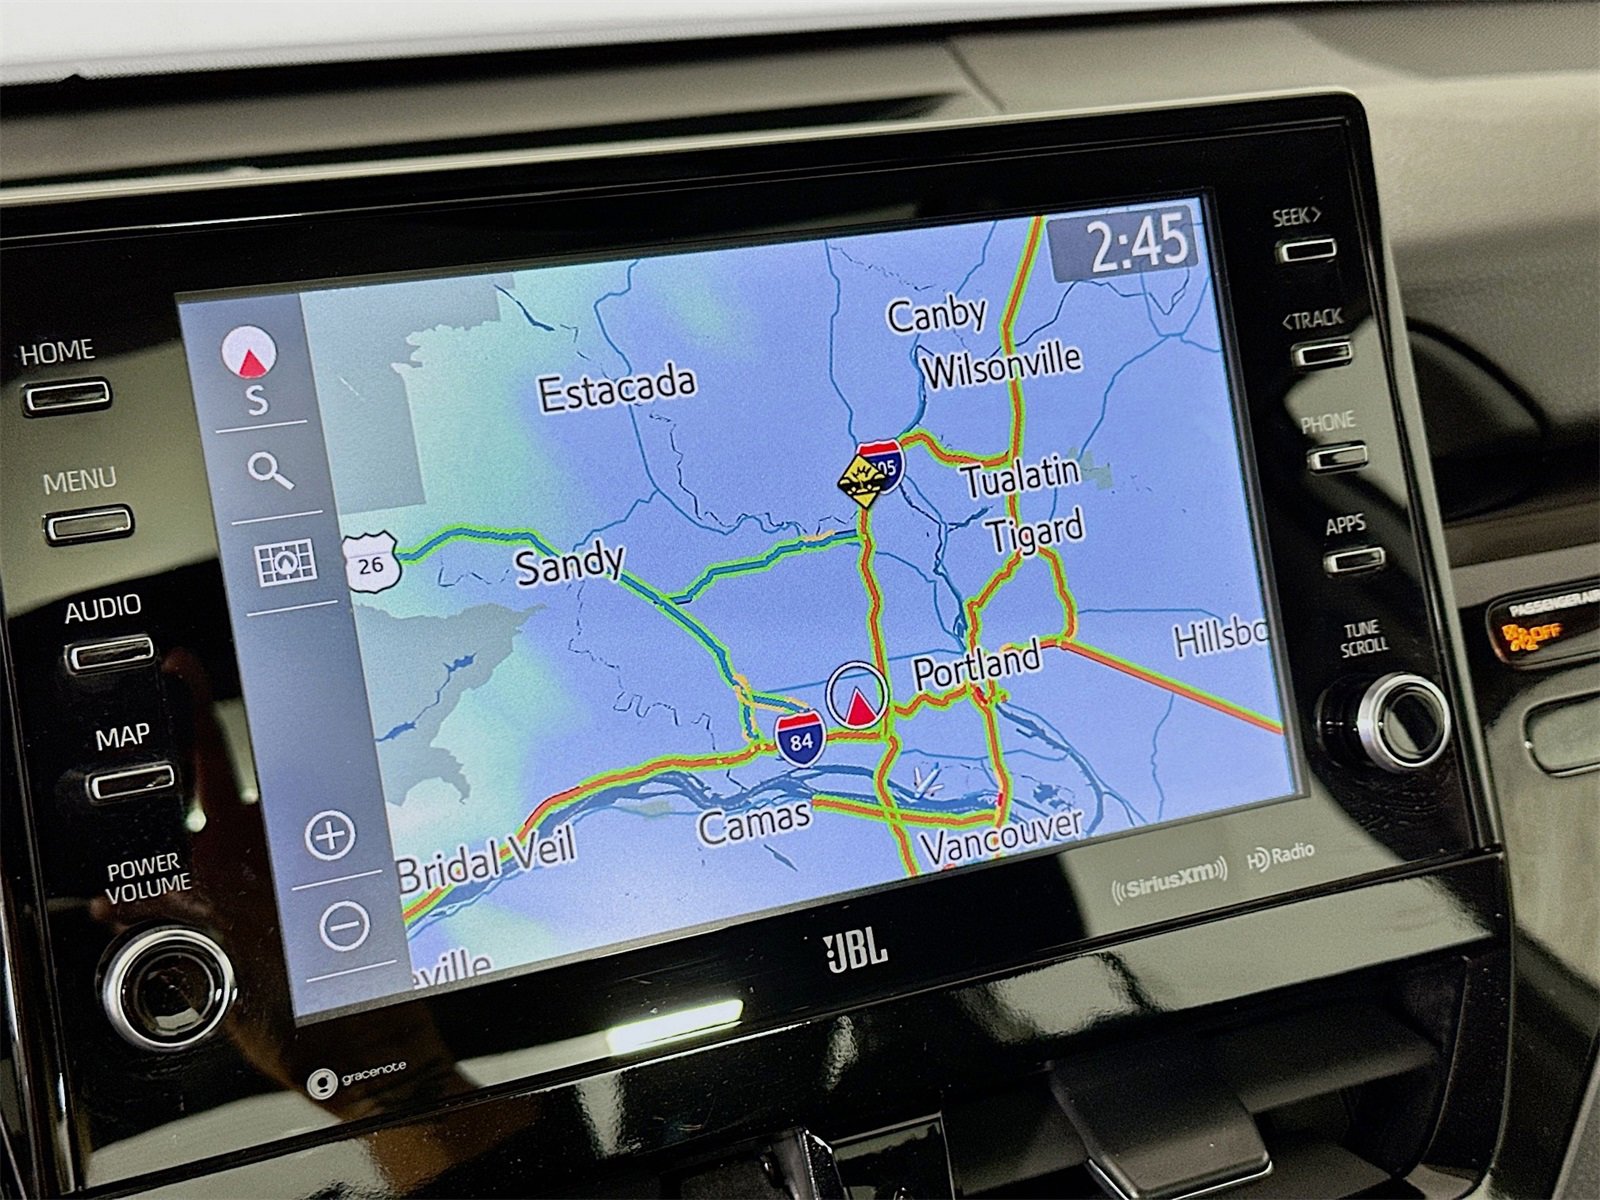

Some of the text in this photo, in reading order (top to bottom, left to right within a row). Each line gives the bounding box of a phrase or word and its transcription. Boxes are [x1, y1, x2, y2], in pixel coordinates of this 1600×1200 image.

[1086, 212, 1190, 274] 2:45
[887, 294, 986, 333] Canby
[20, 338, 96, 366] HOME
[921, 342, 1082, 390] Wilsonville
[245, 384, 270, 416] S
[537, 362, 697, 413] Estacada
[1301, 410, 1356, 434] PHONE
[43, 466, 117, 495] MENU
[959, 457, 1080, 499] Tualatin
[985, 507, 1083, 556] Tigard
[1325, 513, 1367, 536] APPS
[358, 556, 384, 576] 26
[514, 539, 625, 586] Sandy
[64, 593, 142, 624] AUDIO
[1174, 615, 1270, 658] Hillsbo
[1344, 619, 1381, 639] TUNE
[913, 638, 1041, 690] Portland
[1340, 636, 1390, 659] SCROLL
[95, 722, 150, 751] MAP
[789, 733, 813, 752] 84
[699, 799, 811, 845] Camas
[921, 808, 1083, 864] Vancouver
[107, 852, 181, 882] POWER
[397, 825, 576, 895] Bridal Veil
[1272, 842, 1316, 865] Radio
[105, 872, 193, 906] VOLUME
[828, 926, 889, 975] JBL
[341, 1060, 407, 1087] gracenote
